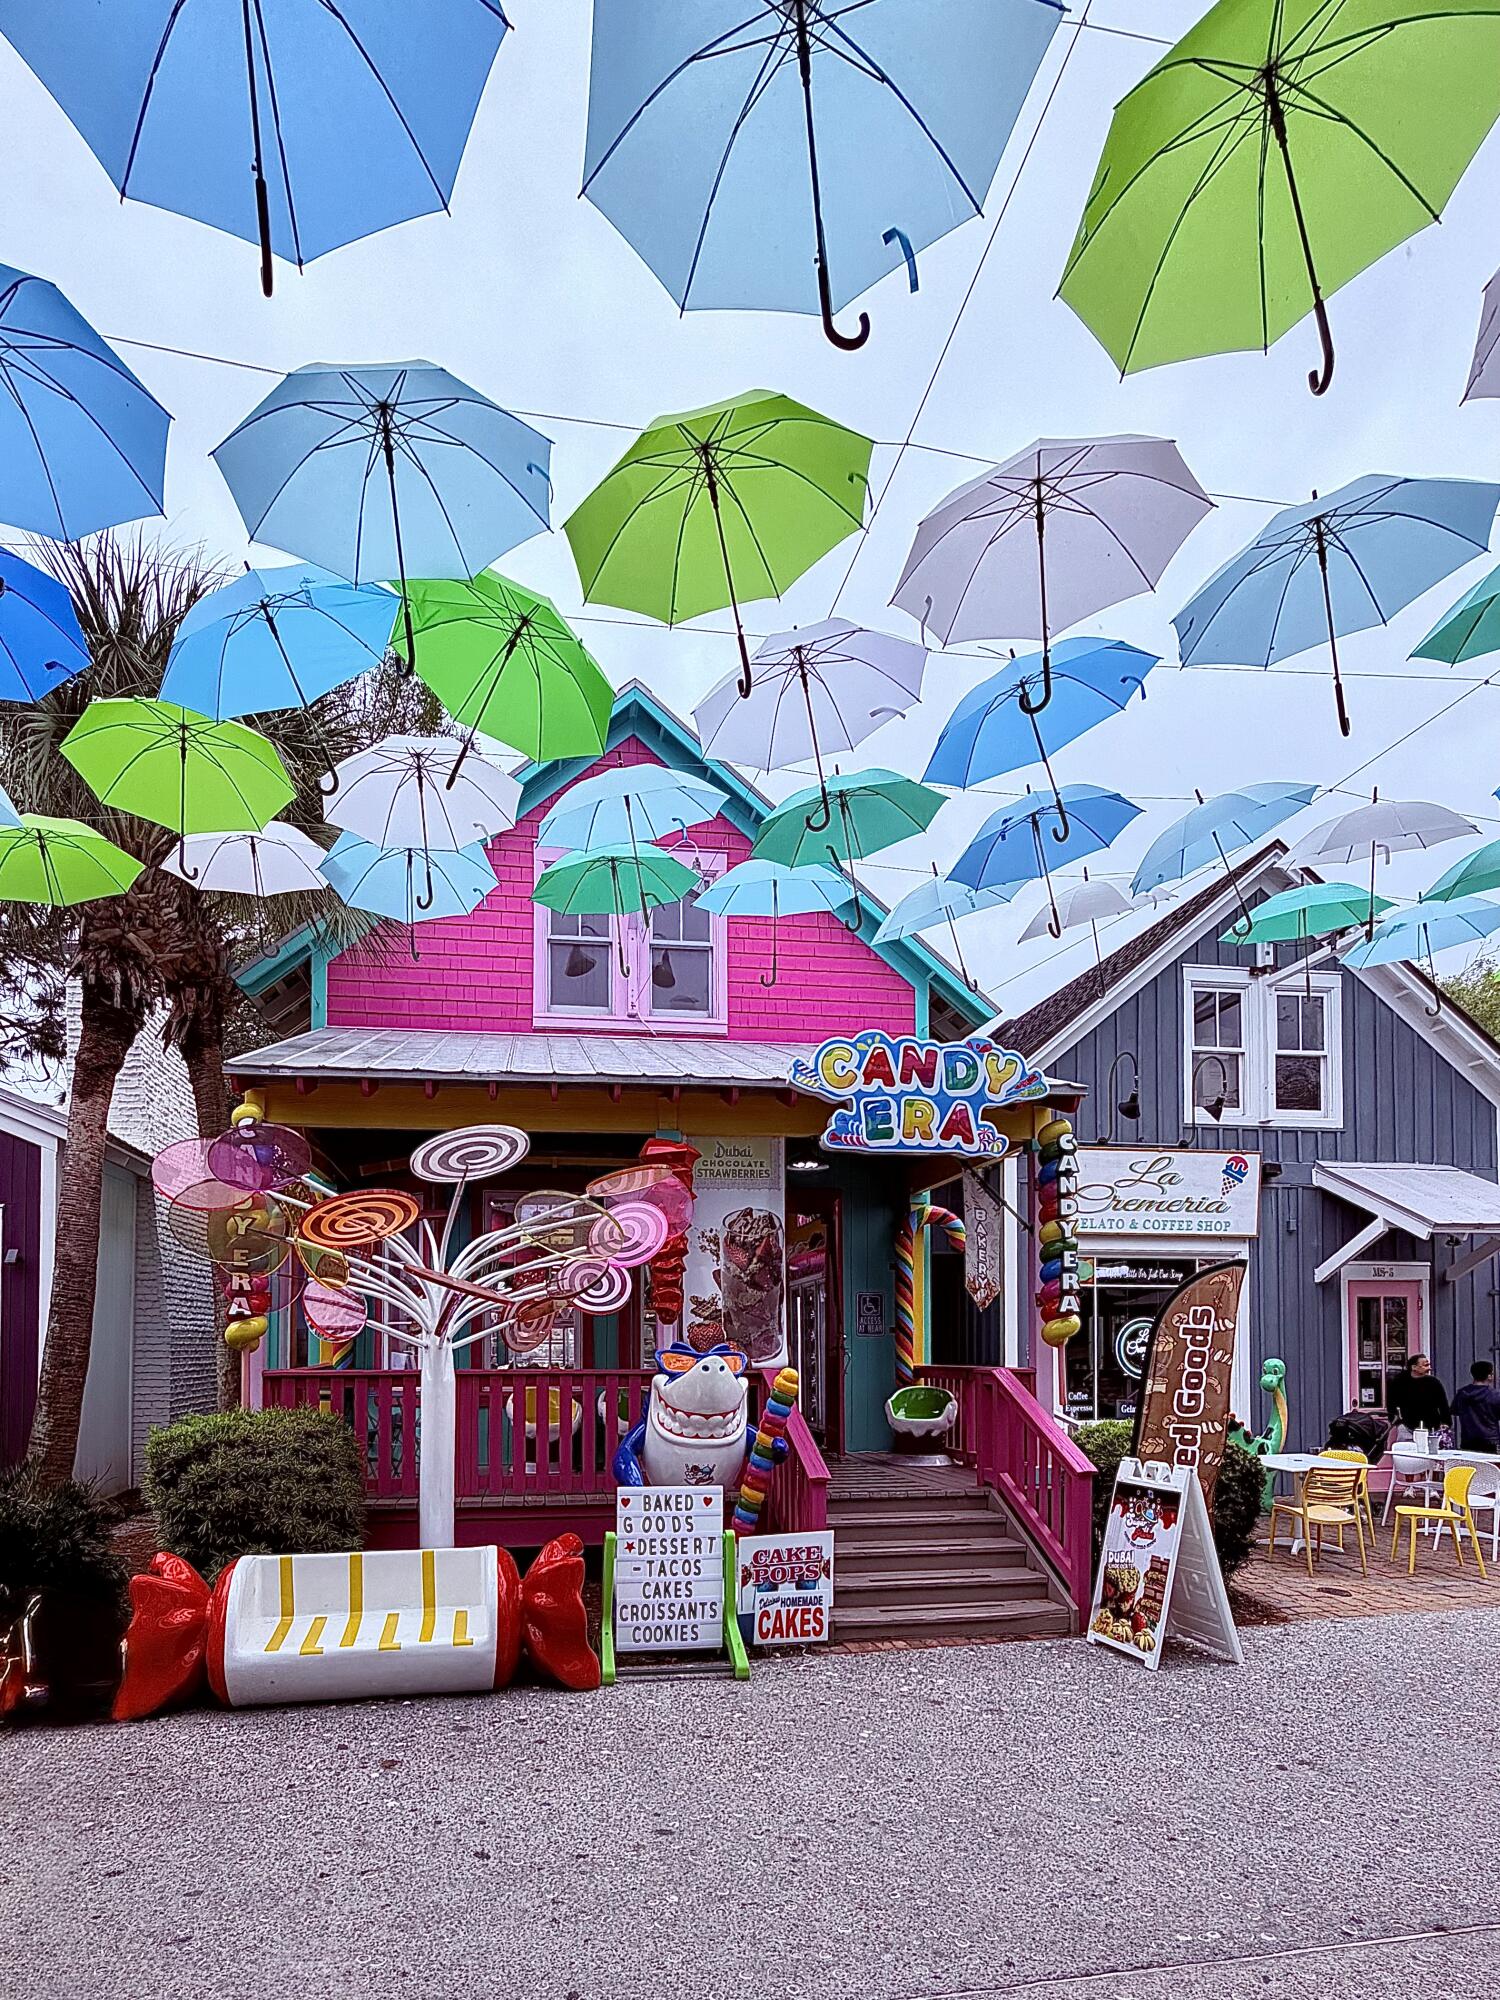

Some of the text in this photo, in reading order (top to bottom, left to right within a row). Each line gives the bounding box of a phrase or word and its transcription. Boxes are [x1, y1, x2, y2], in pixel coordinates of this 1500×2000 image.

[821, 1046, 1019, 1094] CANDY
[863, 1098, 975, 1145] ERA
[714, 1140, 753, 1158] Dubai
[696, 1169, 770, 1179] STRAWBERRIES
[701, 1160, 766, 1168] CHOCOLATE
[1114, 1156, 1184, 1195] La
[1076, 1184, 1231, 1214] Cremeria
[1057, 1133, 1080, 1312] CANDY ERA
[1079, 1218, 1231, 1232] ELATO & COFFEE SHOP
[974, 1207, 988, 1289] BAKERY
[228, 1249, 252, 1315] ERA
[859, 1325, 865, 1333] AT
[860, 1316, 881, 1325] ACCESS
[1173, 1306, 1215, 1417] Goods
[1068, 1391, 1088, 1400] Coffee
[1065, 1404, 1093, 1413] Espresso
[1121, 1404, 1137, 1413] Gela
[643, 1494, 694, 1512] BAKED
[637, 1536, 717, 1556] DESSERT
[752, 1546, 822, 1566] CAKE
[1107, 1550, 1135, 1563] DUBAI
[752, 1563, 821, 1584] POPS
[642, 1581, 693, 1600] CAKES
[619, 1601, 718, 1622] CROISSANTS
[780, 1595, 824, 1608] HOMEMADE
[758, 1607, 824, 1640] CAKES
[632, 1624, 699, 1644] COOKIES
